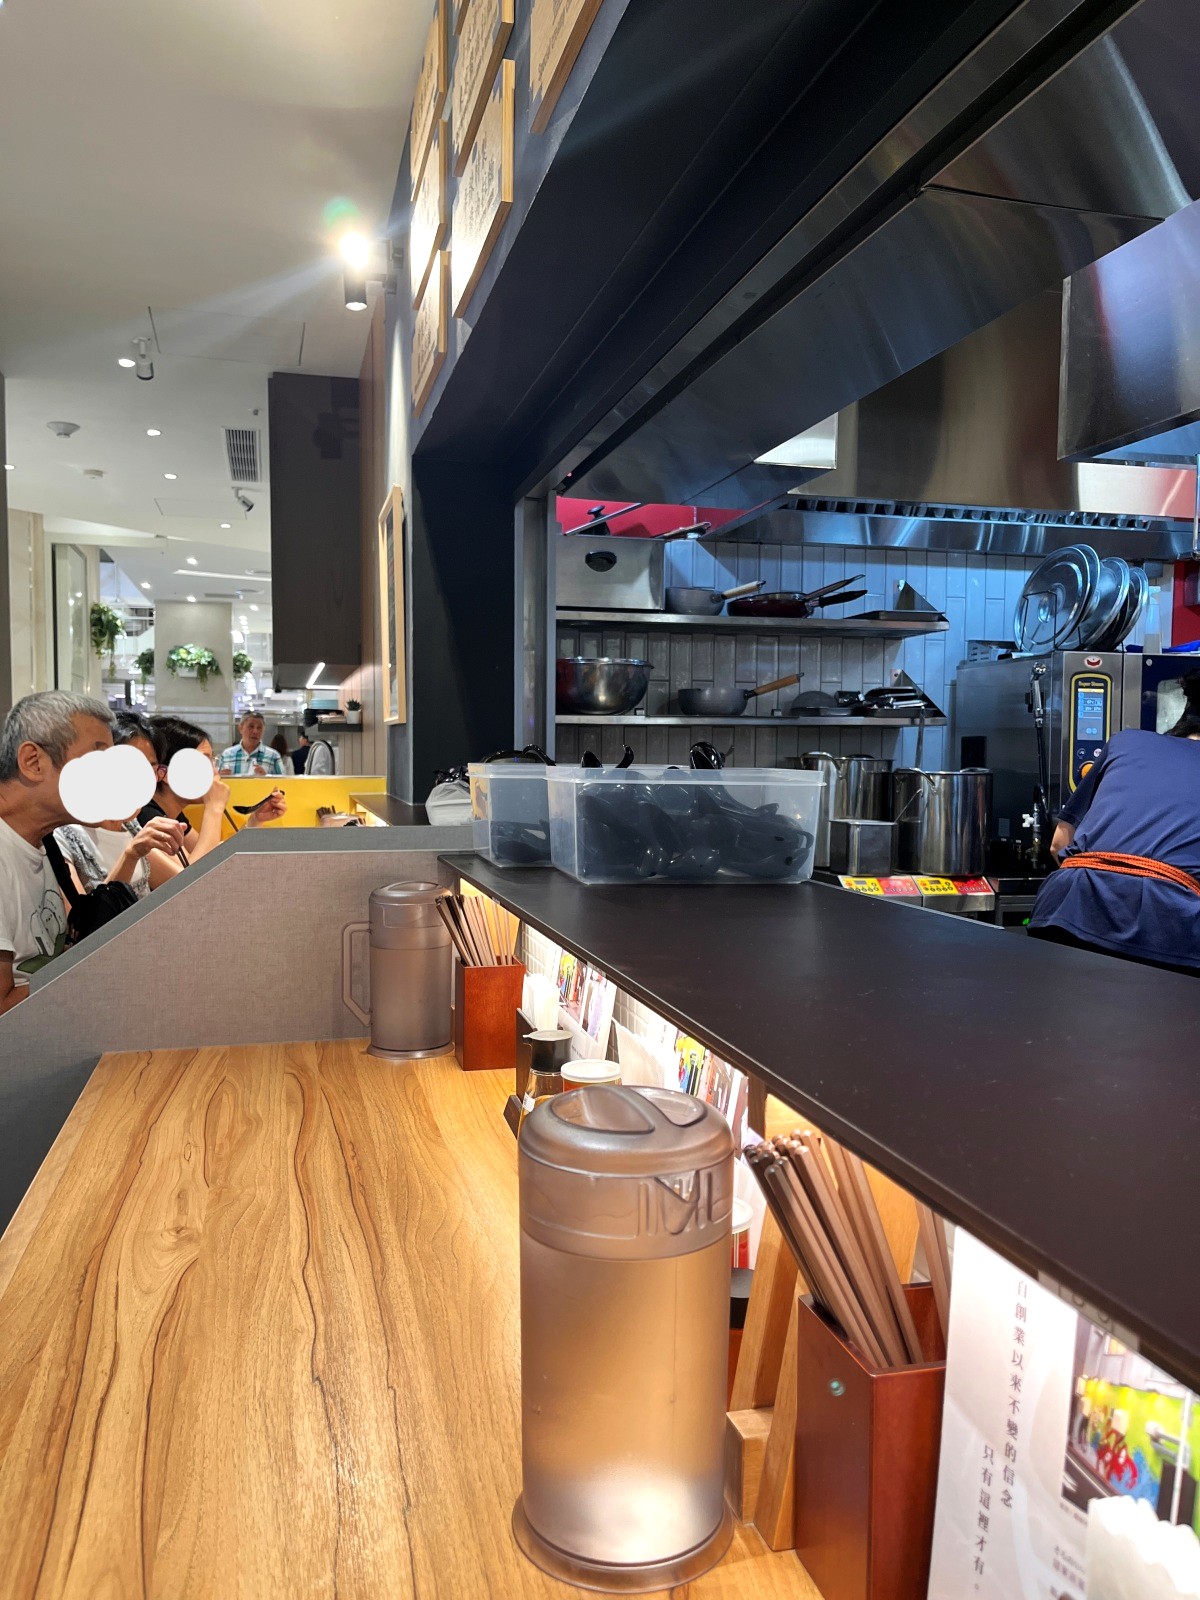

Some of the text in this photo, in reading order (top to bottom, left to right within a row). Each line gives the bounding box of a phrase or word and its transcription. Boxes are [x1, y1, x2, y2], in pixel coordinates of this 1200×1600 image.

[1000, 1281, 1027, 1508] 自創業以來不變的信念
